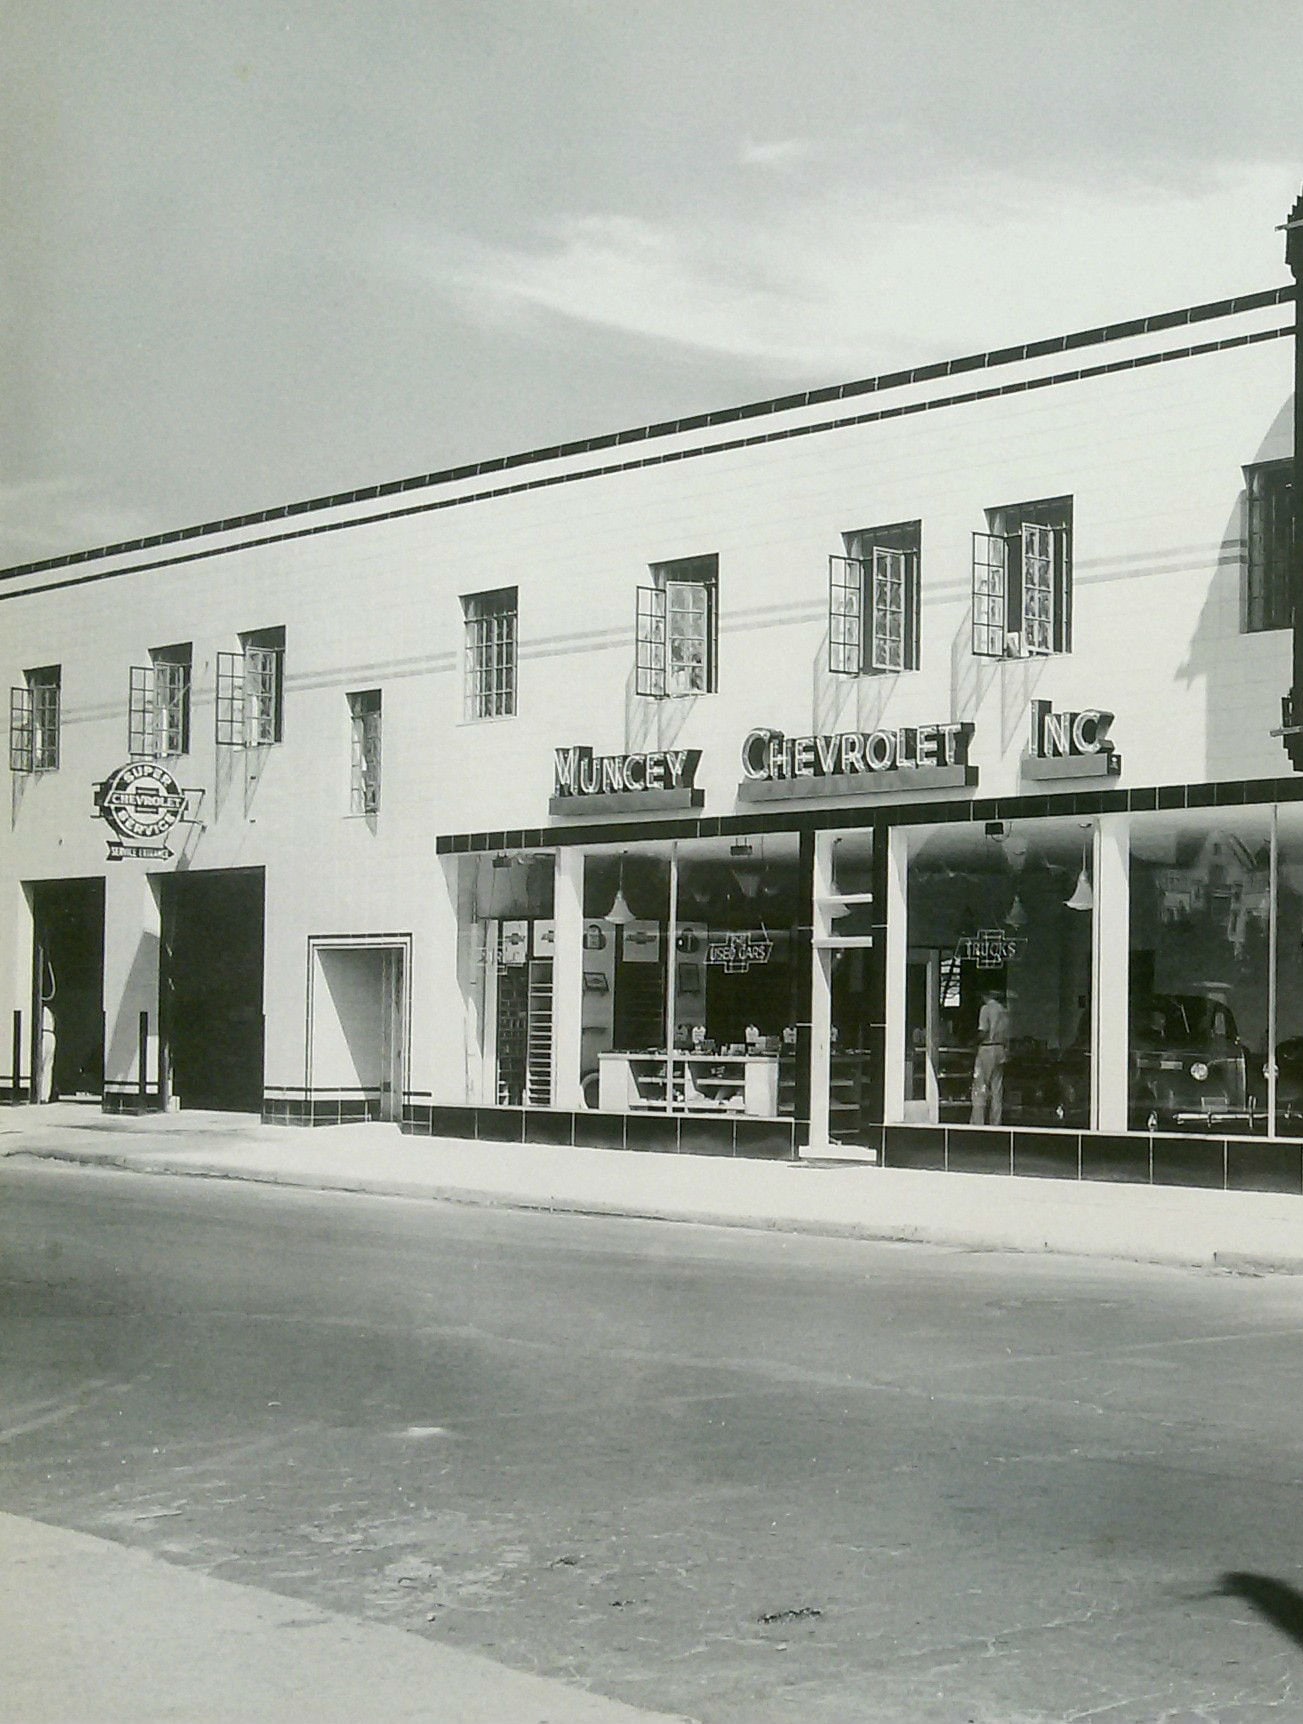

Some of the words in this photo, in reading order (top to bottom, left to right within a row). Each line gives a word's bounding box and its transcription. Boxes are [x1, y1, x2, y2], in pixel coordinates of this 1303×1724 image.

[741, 722, 966, 780] CHEVROLET
[123, 766, 171, 787] SUPER
[112, 794, 181, 807] CHEVROLET
[118, 811, 175, 836] SERVICE
[710, 945, 736, 960] USED
[738, 944, 767, 960] CARS
[965, 942, 1017, 957] TRUCKS
